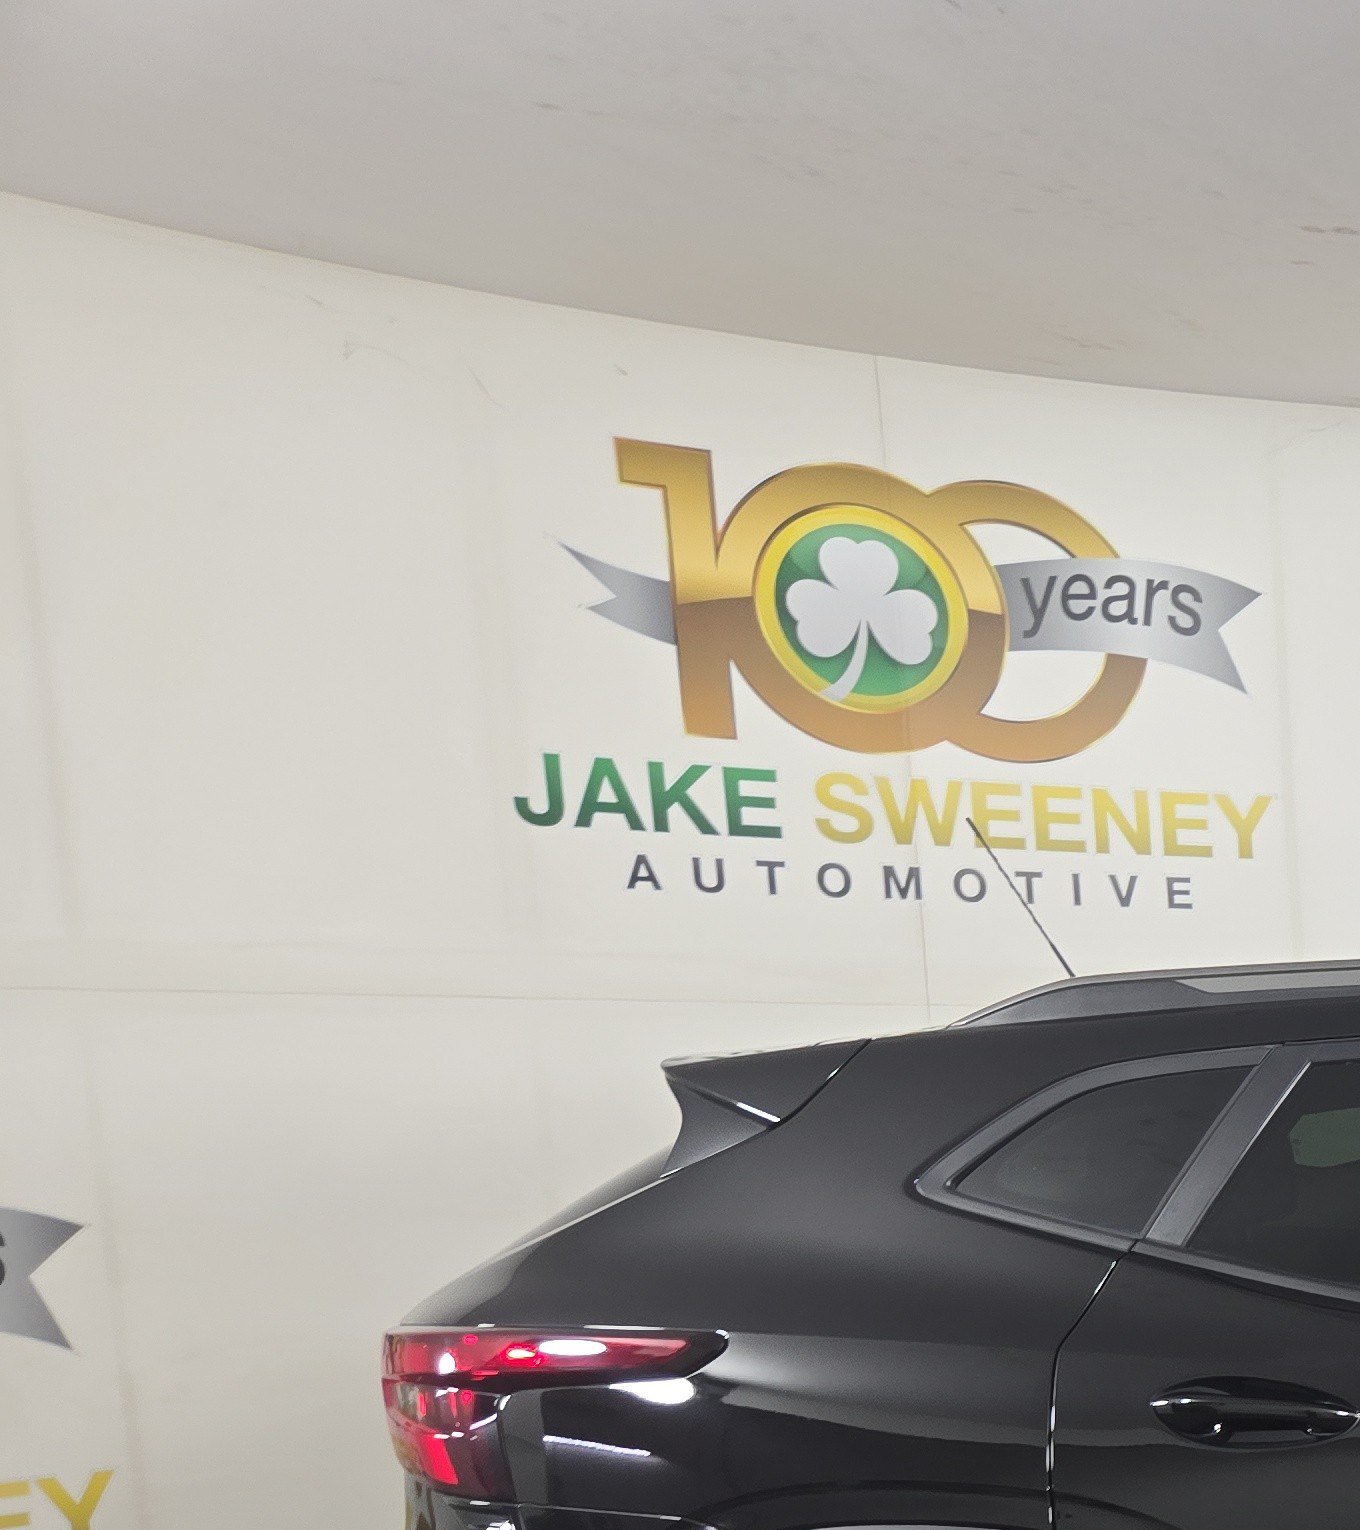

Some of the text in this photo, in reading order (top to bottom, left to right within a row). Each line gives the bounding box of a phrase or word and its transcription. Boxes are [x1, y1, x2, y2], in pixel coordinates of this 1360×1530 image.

[1020, 567, 1204, 640] years
[512, 751, 1273, 860] JAKE SWEENEY
[625, 853, 1194, 911] AUTOMOTIVE
